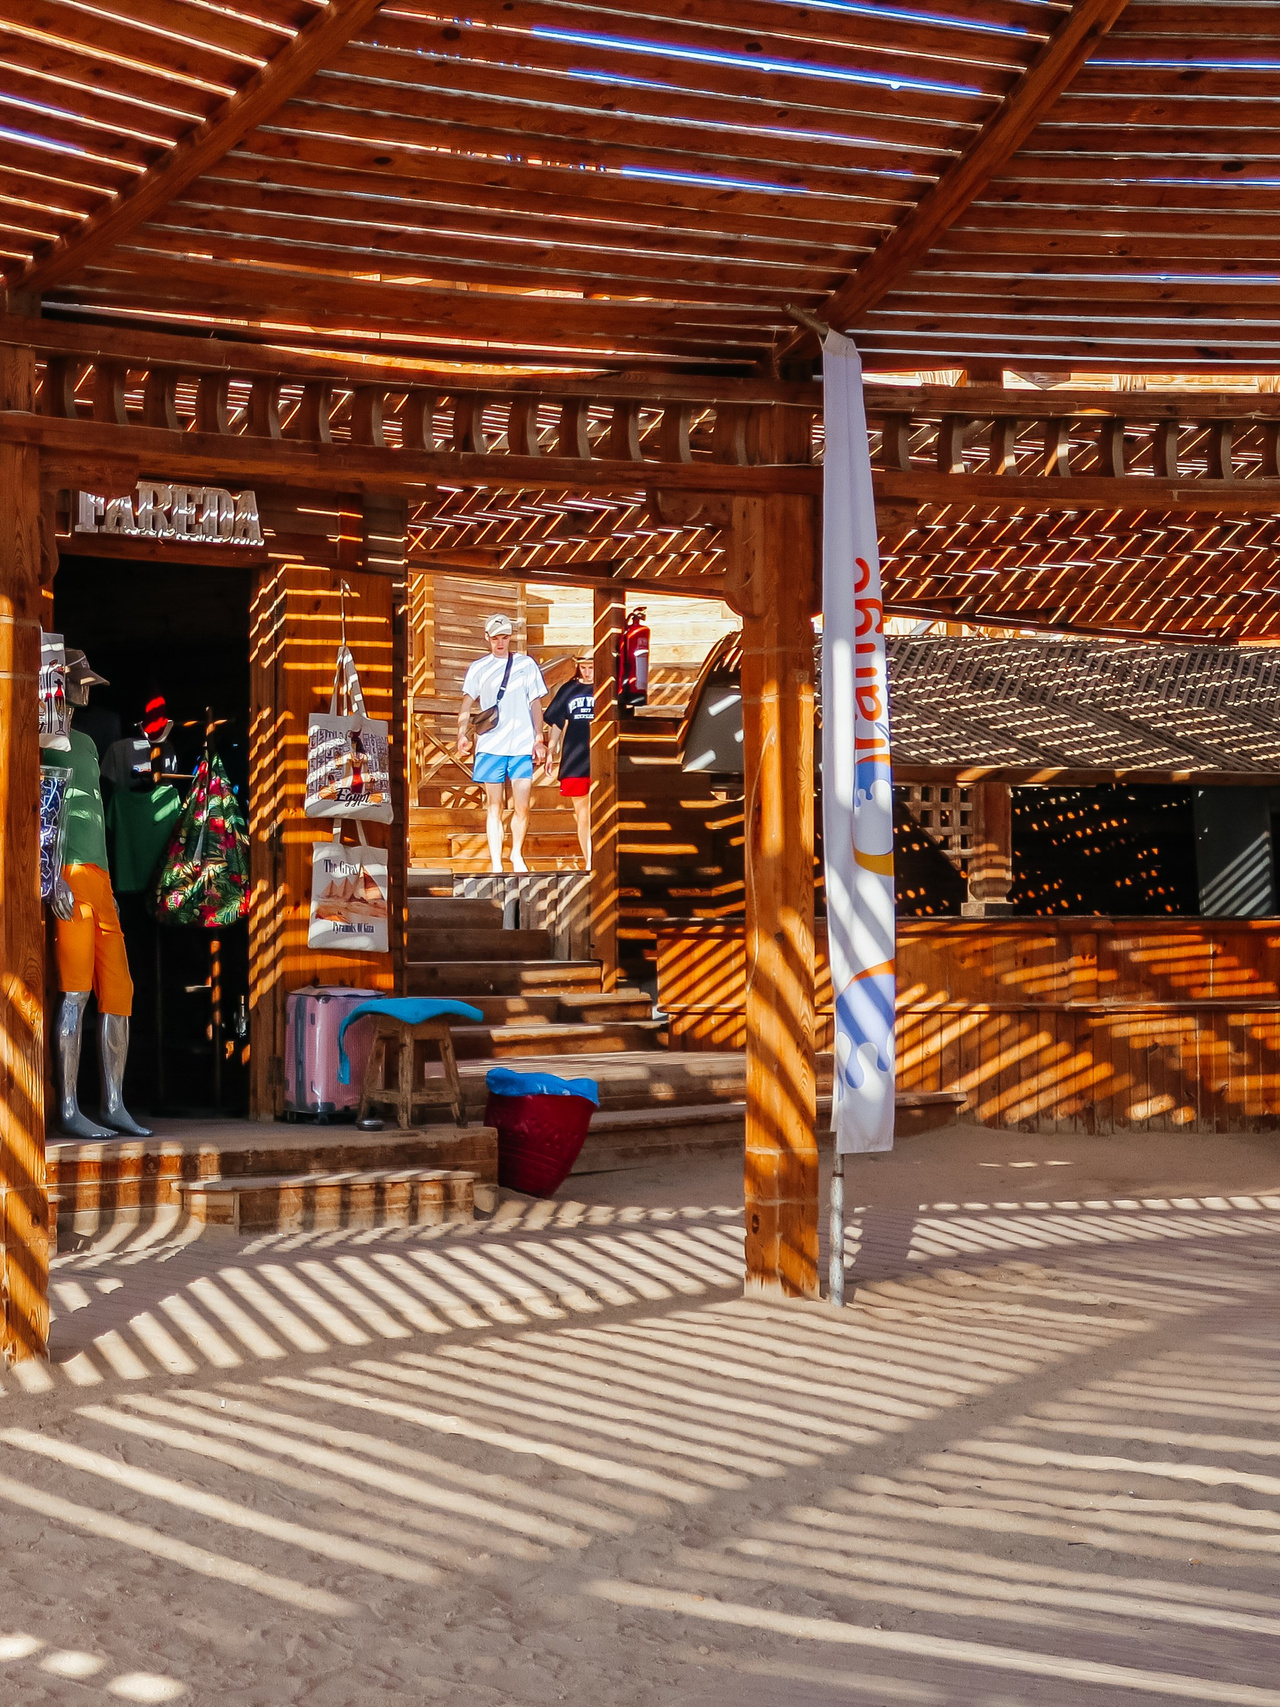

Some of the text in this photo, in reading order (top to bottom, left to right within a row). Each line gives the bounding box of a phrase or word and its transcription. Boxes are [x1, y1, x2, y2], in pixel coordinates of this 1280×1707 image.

[334, 788, 371, 807] Egypt
[324, 859, 338, 873] The
[332, 921, 356, 934] Pyramids
